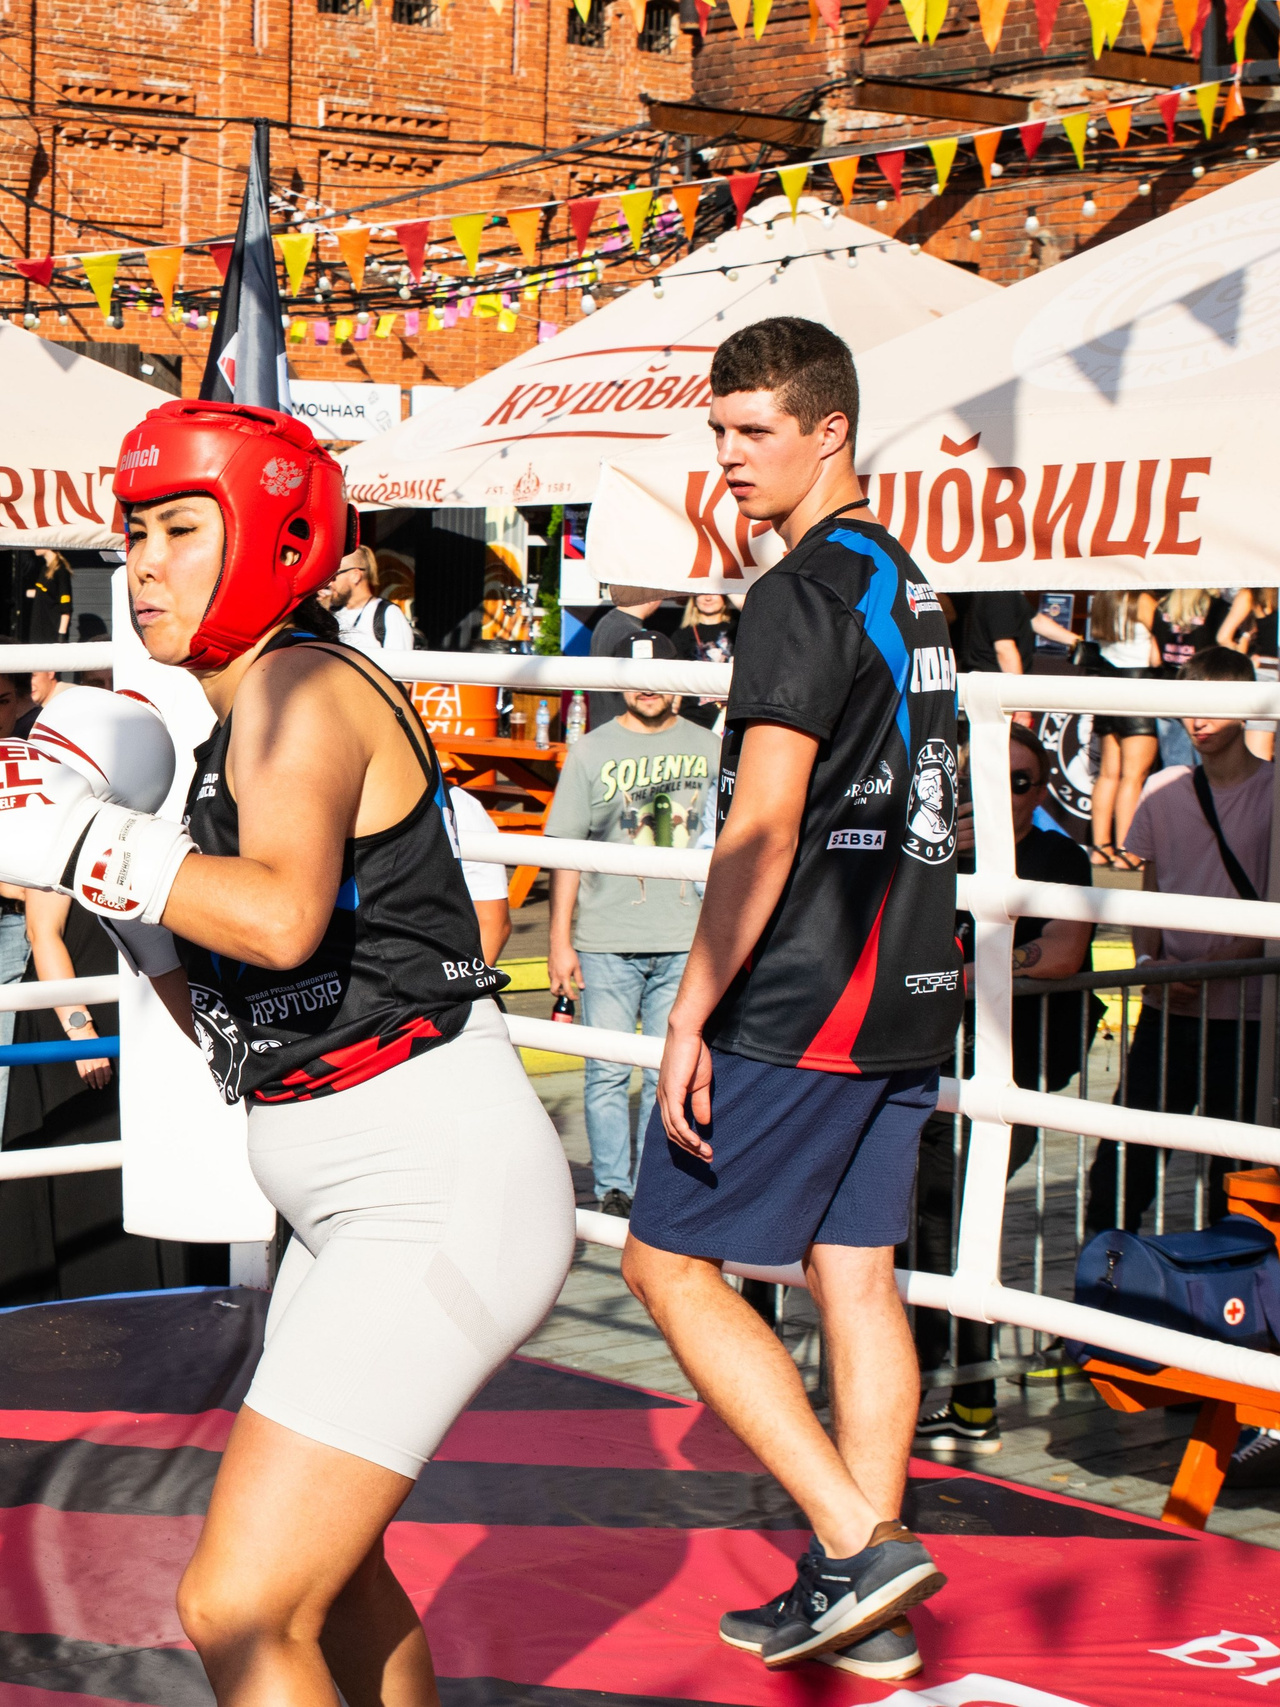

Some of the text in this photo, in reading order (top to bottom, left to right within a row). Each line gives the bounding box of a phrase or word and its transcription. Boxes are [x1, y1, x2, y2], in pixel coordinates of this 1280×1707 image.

[547, 483, 571, 493] 1581
[601, 754, 708, 803] SOLENYA
[631, 792, 647, 802] THE
[831, 832, 883, 846] SIBSA
[475, 975, 497, 988] GIN
[250, 979, 342, 1027] КРУТОЯР
